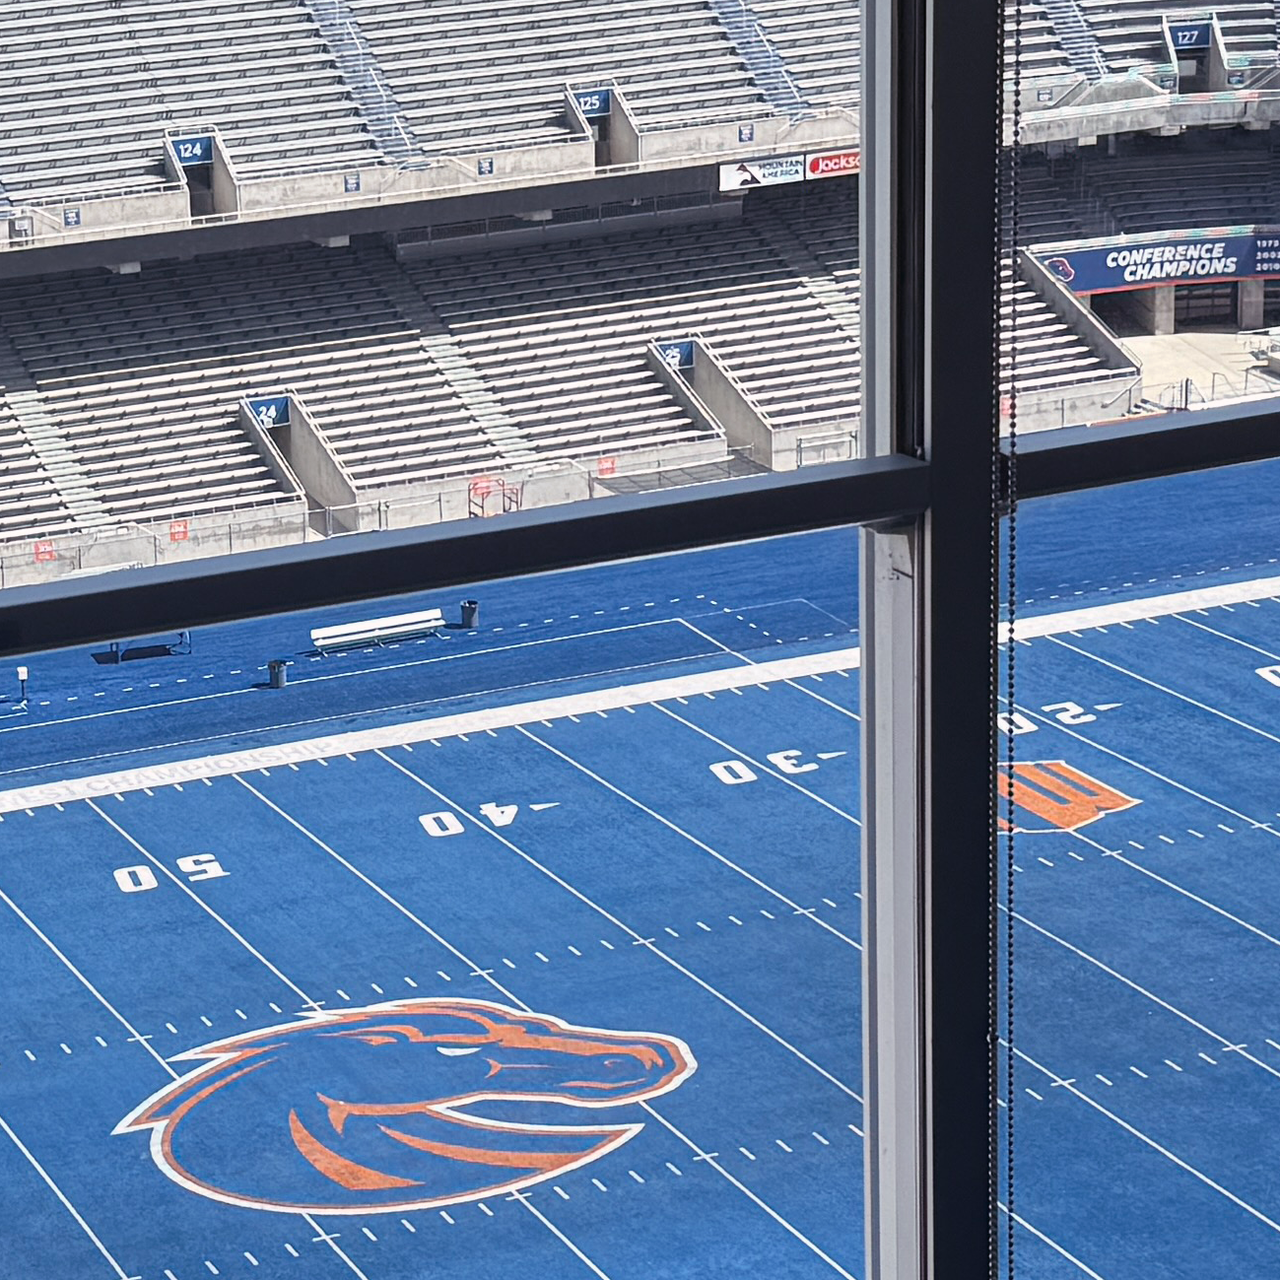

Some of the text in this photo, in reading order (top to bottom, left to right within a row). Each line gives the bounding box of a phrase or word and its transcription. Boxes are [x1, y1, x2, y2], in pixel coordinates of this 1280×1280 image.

[1177, 30, 1199, 45] 127
[579, 95, 600, 111] 125
[178, 143, 203, 158] 124
[758, 159, 803, 171] MOUNTAIN
[762, 169, 800, 179] AMERICA
[1106, 243, 1225, 267] CONFERENCE
[1124, 257, 1237, 282] CHAMPIONS
[258, 405, 277, 421] 24
[85, 740, 334, 793] CHAMPIONSHIP
[709, 749, 819, 785] 30
[419, 802, 519, 838] 40
[113, 853, 230, 894] 50
